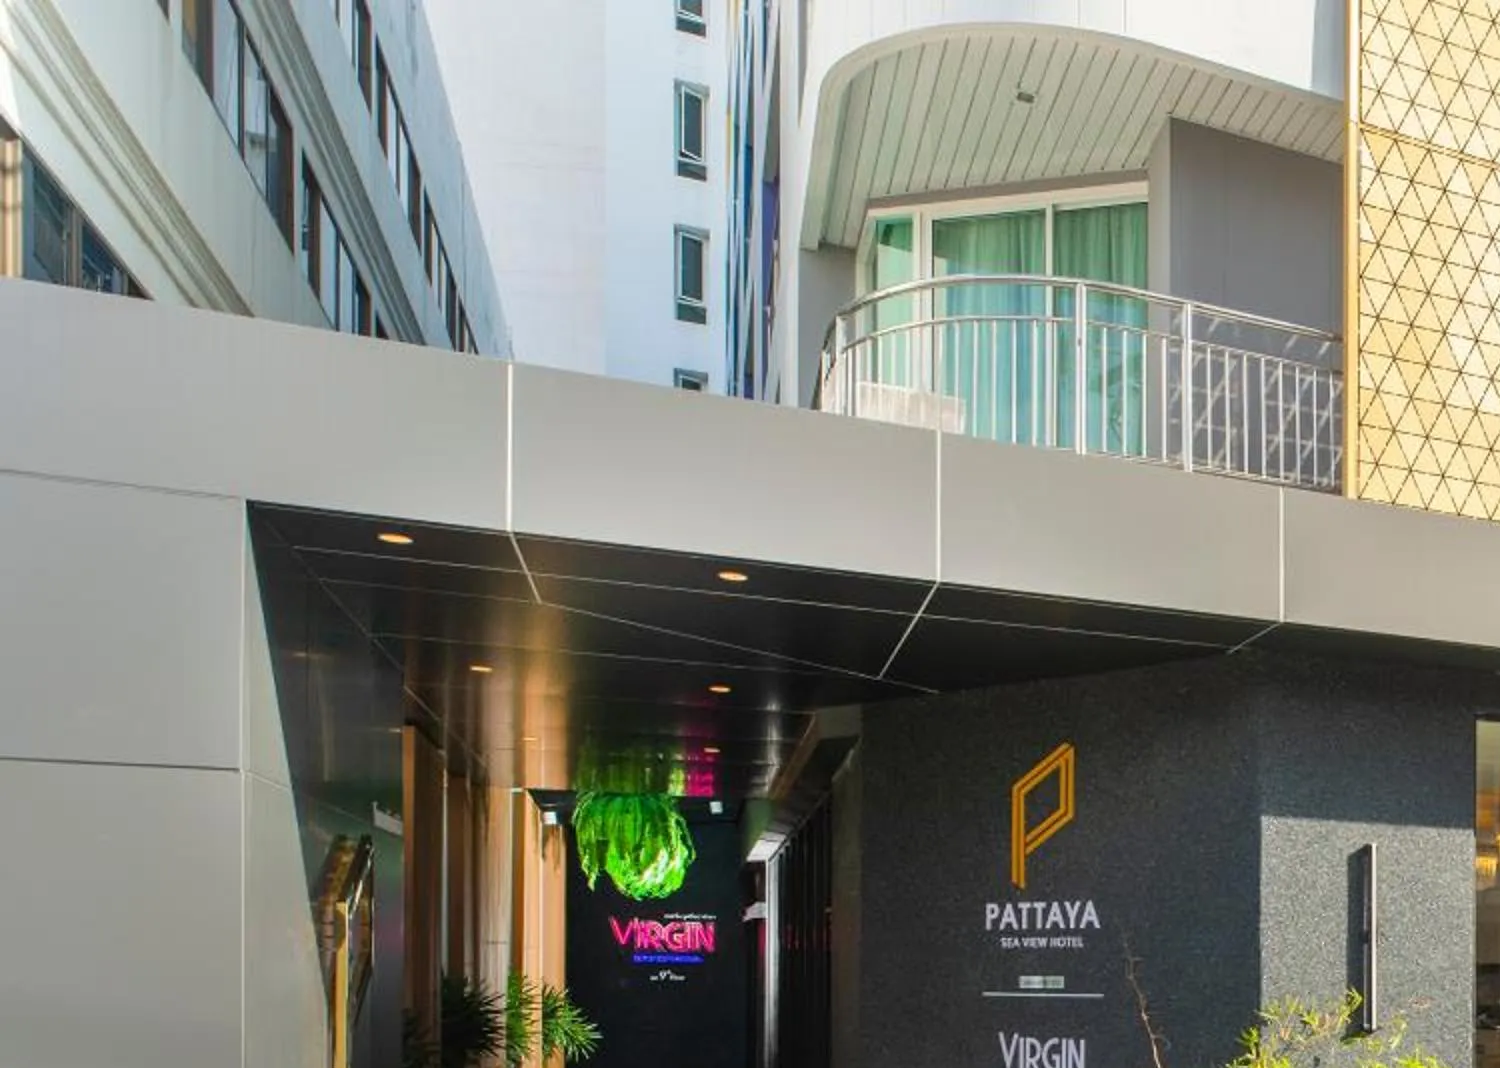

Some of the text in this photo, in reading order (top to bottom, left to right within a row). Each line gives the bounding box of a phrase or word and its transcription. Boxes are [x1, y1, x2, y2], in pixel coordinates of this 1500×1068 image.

[985, 900, 1101, 930] PATTAYA
[609, 916, 715, 953] VIRGIN
[1001, 936, 1084, 949] SEA VIEW HOTEL
